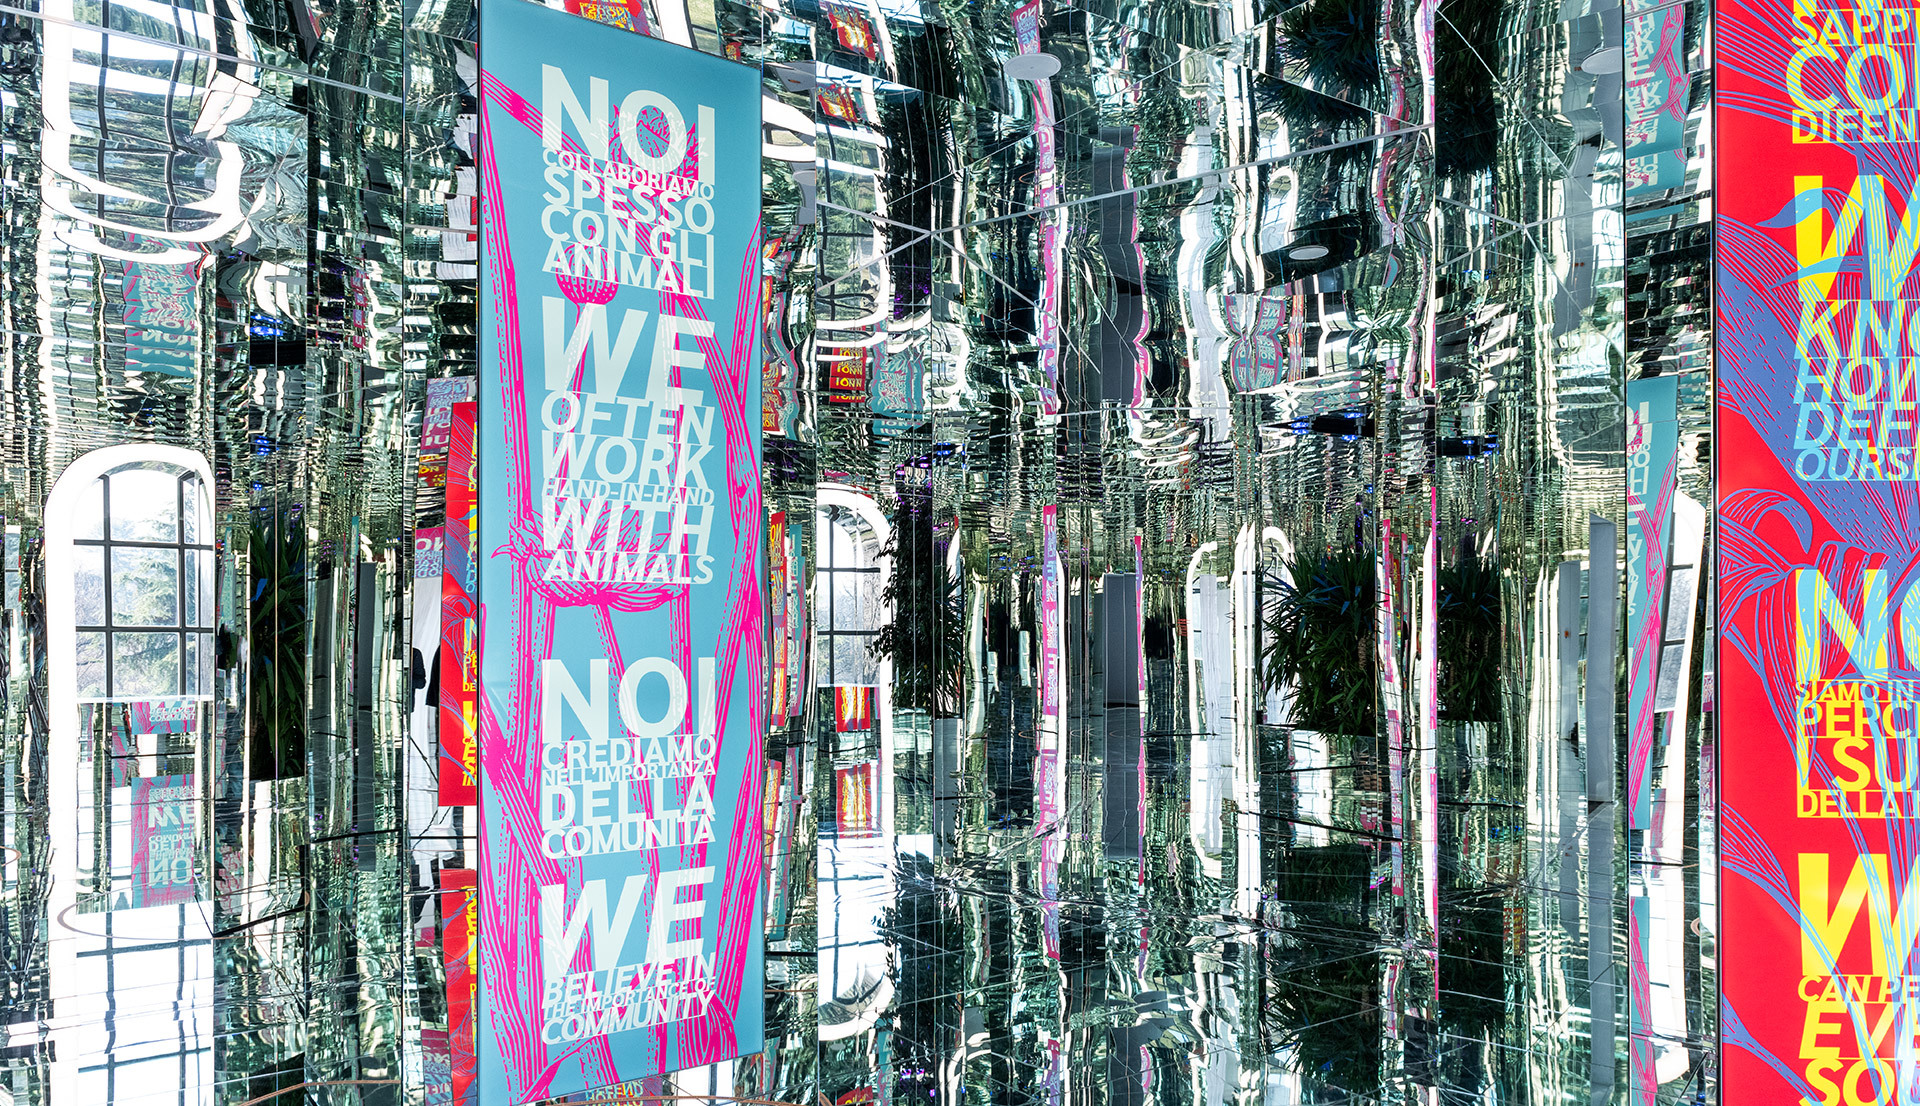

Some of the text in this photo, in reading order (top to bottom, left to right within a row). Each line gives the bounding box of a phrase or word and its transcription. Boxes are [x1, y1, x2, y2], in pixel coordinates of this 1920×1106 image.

[542, 63, 715, 185] NOI
[542, 149, 714, 200] COLLABORIAMO
[542, 167, 715, 234] SPESSO
[542, 204, 714, 267] CON GLI
[542, 238, 714, 299] ANIMALI
[542, 296, 715, 406] WE
[1794, 300, 1920, 359] KN
[541, 390, 715, 446] OFTEN
[1793, 401, 1920, 449] DEF
[542, 430, 715, 489] WORK
[542, 478, 715, 505] HAND-IN-HAND
[542, 497, 715, 555] WITH
[542, 550, 715, 585] ANIMALS
[1796, 569, 1920, 681] N
[542, 657, 715, 744] NOI
[1796, 679, 1880, 702] SIAMO
[542, 734, 716, 771] CREDIAMO
[542, 759, 716, 786] NELL'IMPORTANZA
[1832, 737, 1918, 791] SU
[542, 773, 716, 830] DELLA
[1797, 791, 1902, 818] DELLA
[541, 866, 716, 980] WE
[542, 952, 716, 1009] BELIEVE IN
[543, 976, 716, 1021] THE IMPORTANCE OF
[1798, 975, 1871, 1002] CAN
[542, 990, 716, 1045] COMMUNITY
